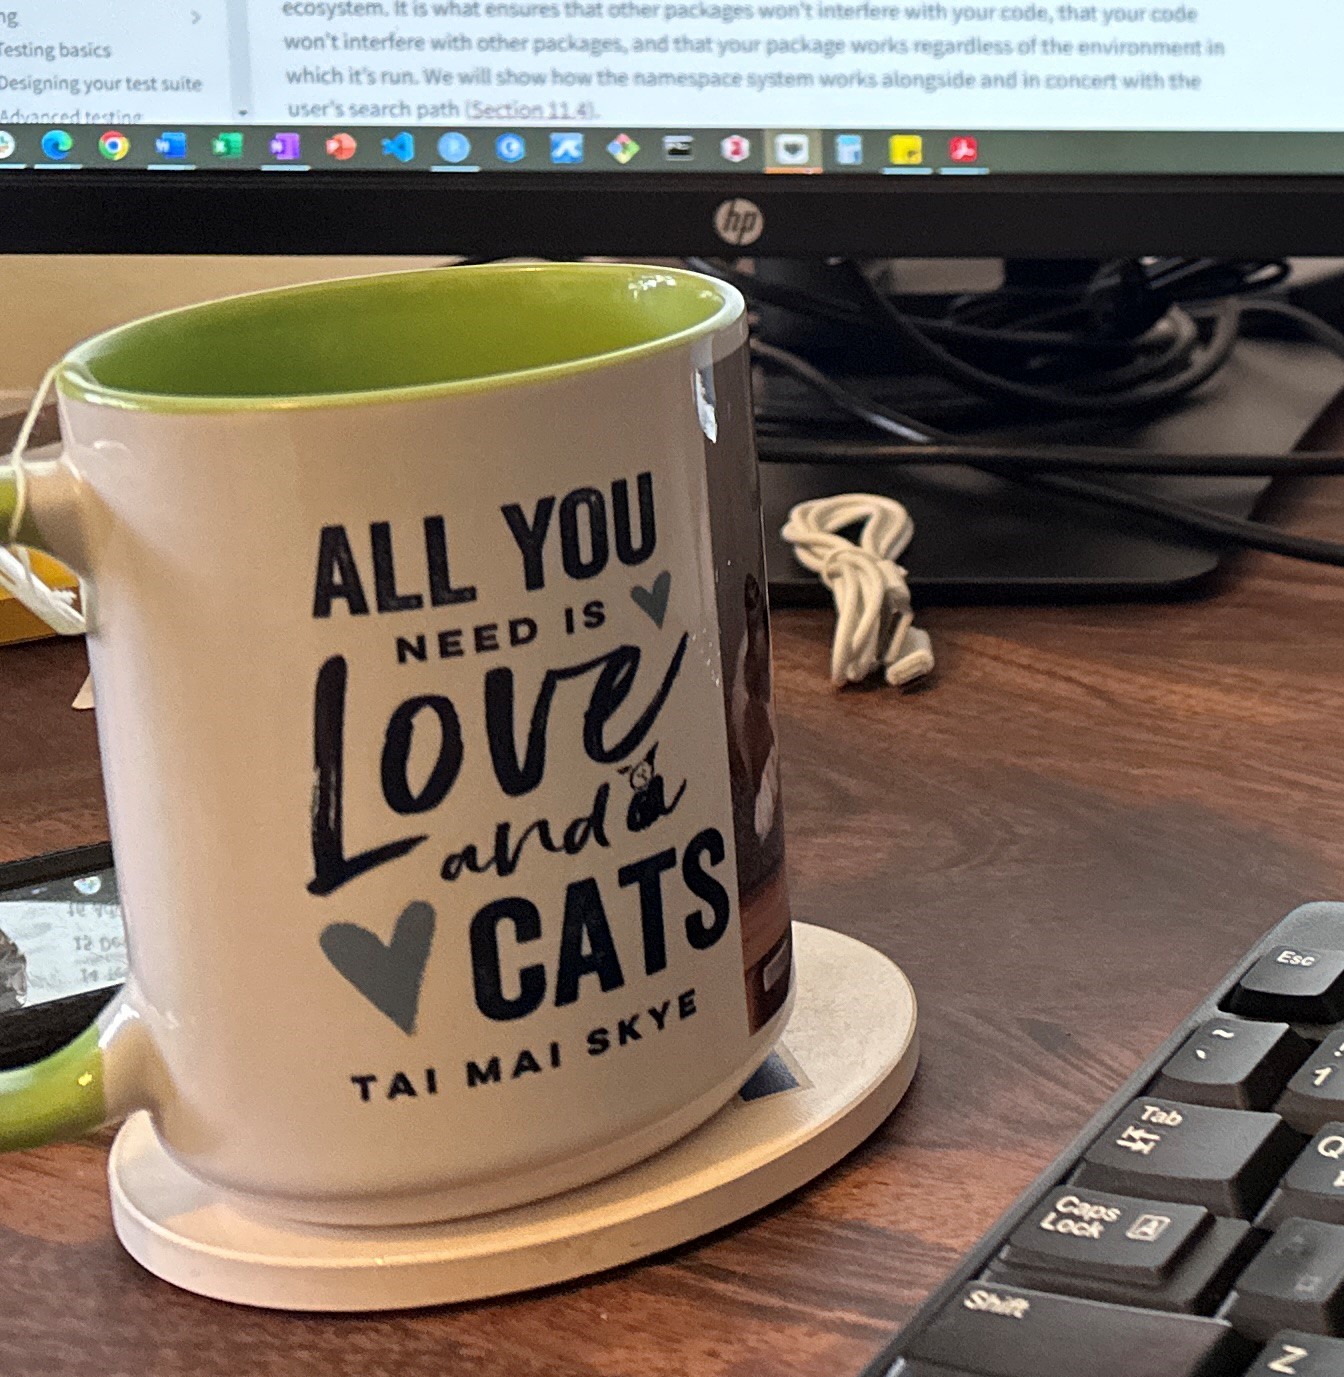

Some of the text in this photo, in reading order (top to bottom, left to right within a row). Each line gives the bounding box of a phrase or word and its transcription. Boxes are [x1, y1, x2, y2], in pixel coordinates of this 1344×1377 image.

[287, 99, 460, 120] user's search path
[313, 471, 656, 618] ALL YOU
[396, 600, 605, 664] NEED IS
[441, 780, 610, 881] and
[468, 827, 731, 1022] CATS
[1276, 950, 1316, 966] Esc
[351, 988, 696, 1101] TAI MAI SKYE
[1141, 1105, 1183, 1126] Tab
[1056, 1196, 1120, 1221] Caps
[1041, 1212, 1103, 1238] Lock
[965, 1291, 1029, 1317] Shift
